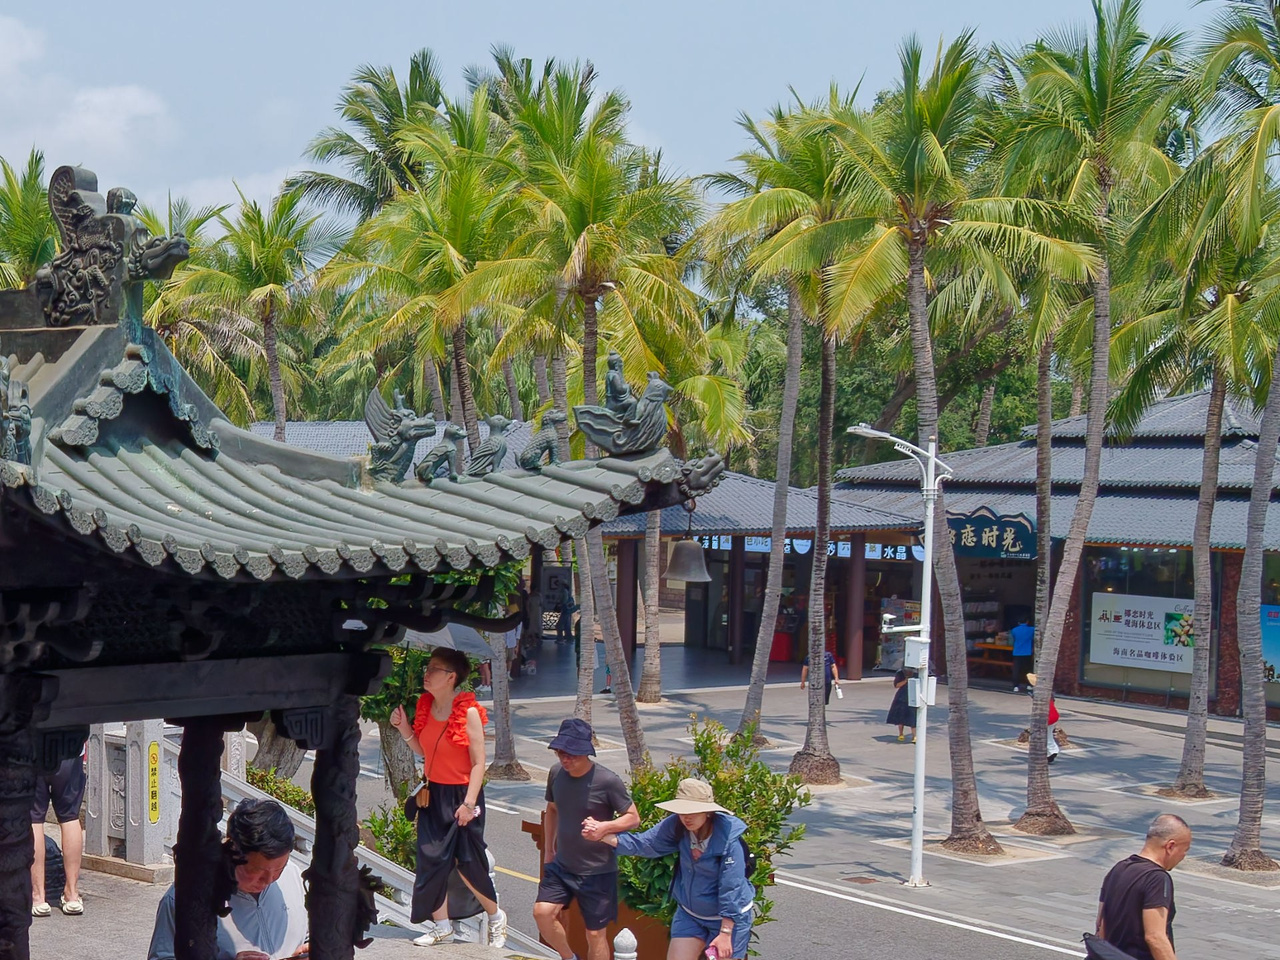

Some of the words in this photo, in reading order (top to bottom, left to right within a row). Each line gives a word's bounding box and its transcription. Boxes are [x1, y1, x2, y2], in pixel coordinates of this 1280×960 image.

[883, 545, 907, 560] 水晶
[1124, 619, 1161, 631] 观海休息区
[1113, 647, 1184, 662] 海南名品咖啡体验区
